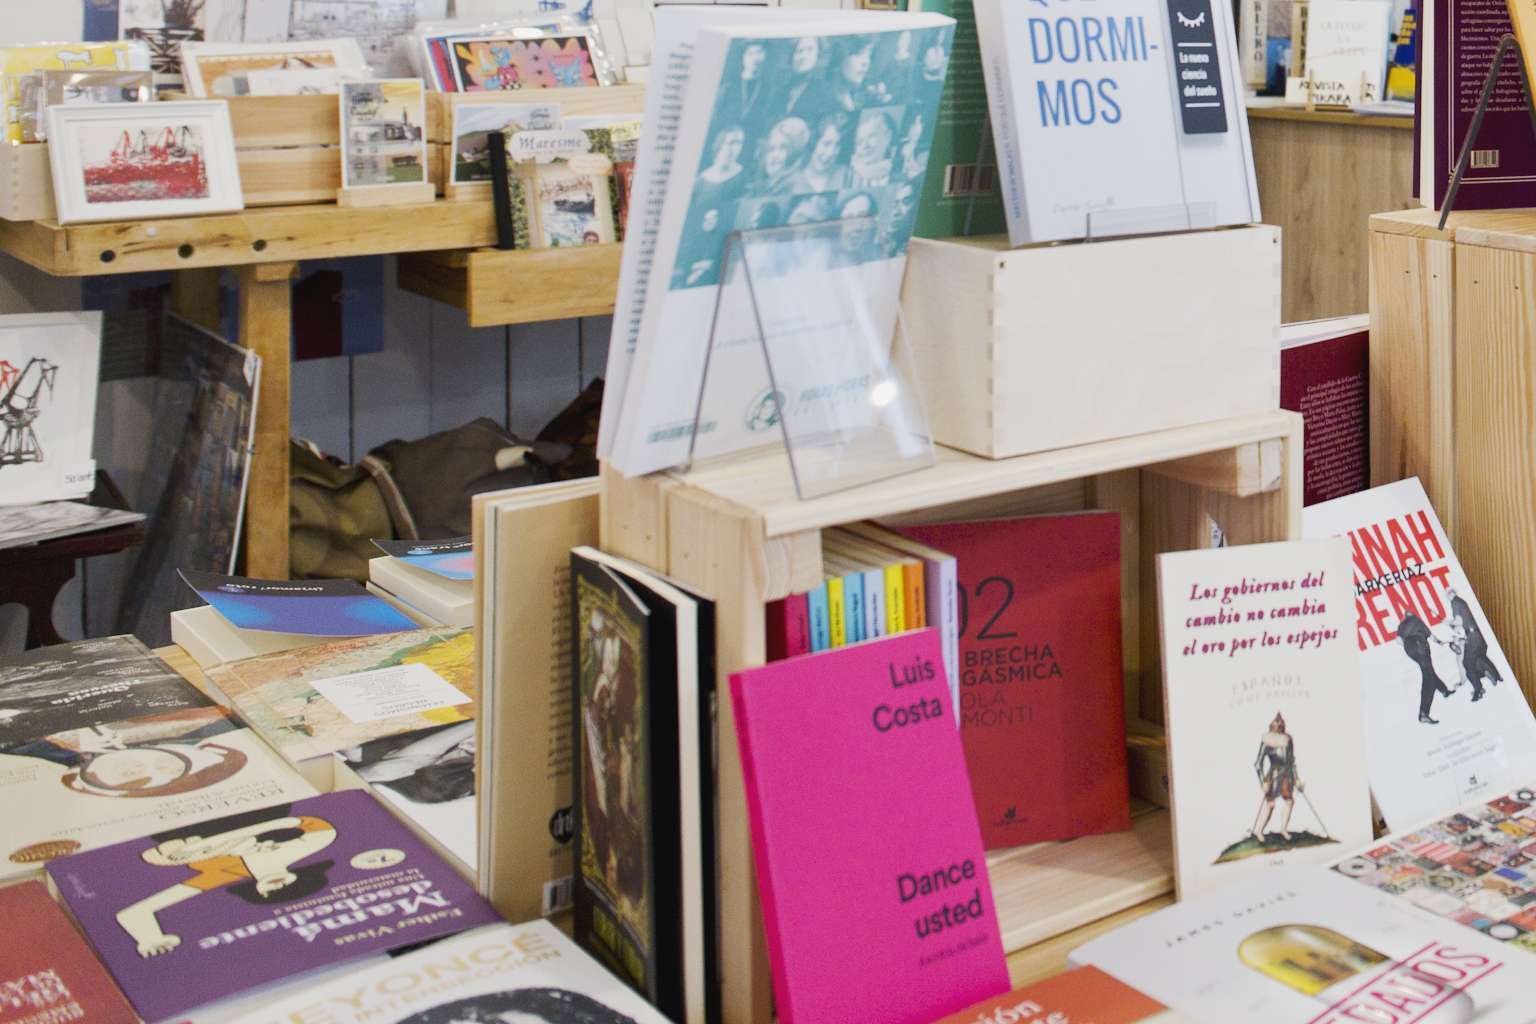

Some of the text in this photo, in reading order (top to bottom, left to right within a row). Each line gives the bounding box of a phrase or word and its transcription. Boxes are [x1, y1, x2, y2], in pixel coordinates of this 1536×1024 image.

[1028, 15, 1159, 65] DORMI-
[1036, 77, 1123, 128] MOS
[1340, 510, 1446, 568] NNAH
[1189, 570, 1326, 606] Los gobiernos del
[1185, 597, 1327, 630] cambio no cambia
[964, 644, 1055, 668] BRECHA
[1182, 626, 1339, 659] el oro por los espejos
[888, 657, 936, 691] Luis
[871, 696, 945, 734] Costa
[896, 856, 977, 904] Dance
[199, 880, 434, 950] desobediente
[292, 889, 451, 943] Mamá
[334, 908, 464, 946] Esther Vivas
[914, 891, 985, 940] usted
[1165, 889, 1300, 950] JAMES DAVIES
[1320, 944, 1491, 1024] DADOS
